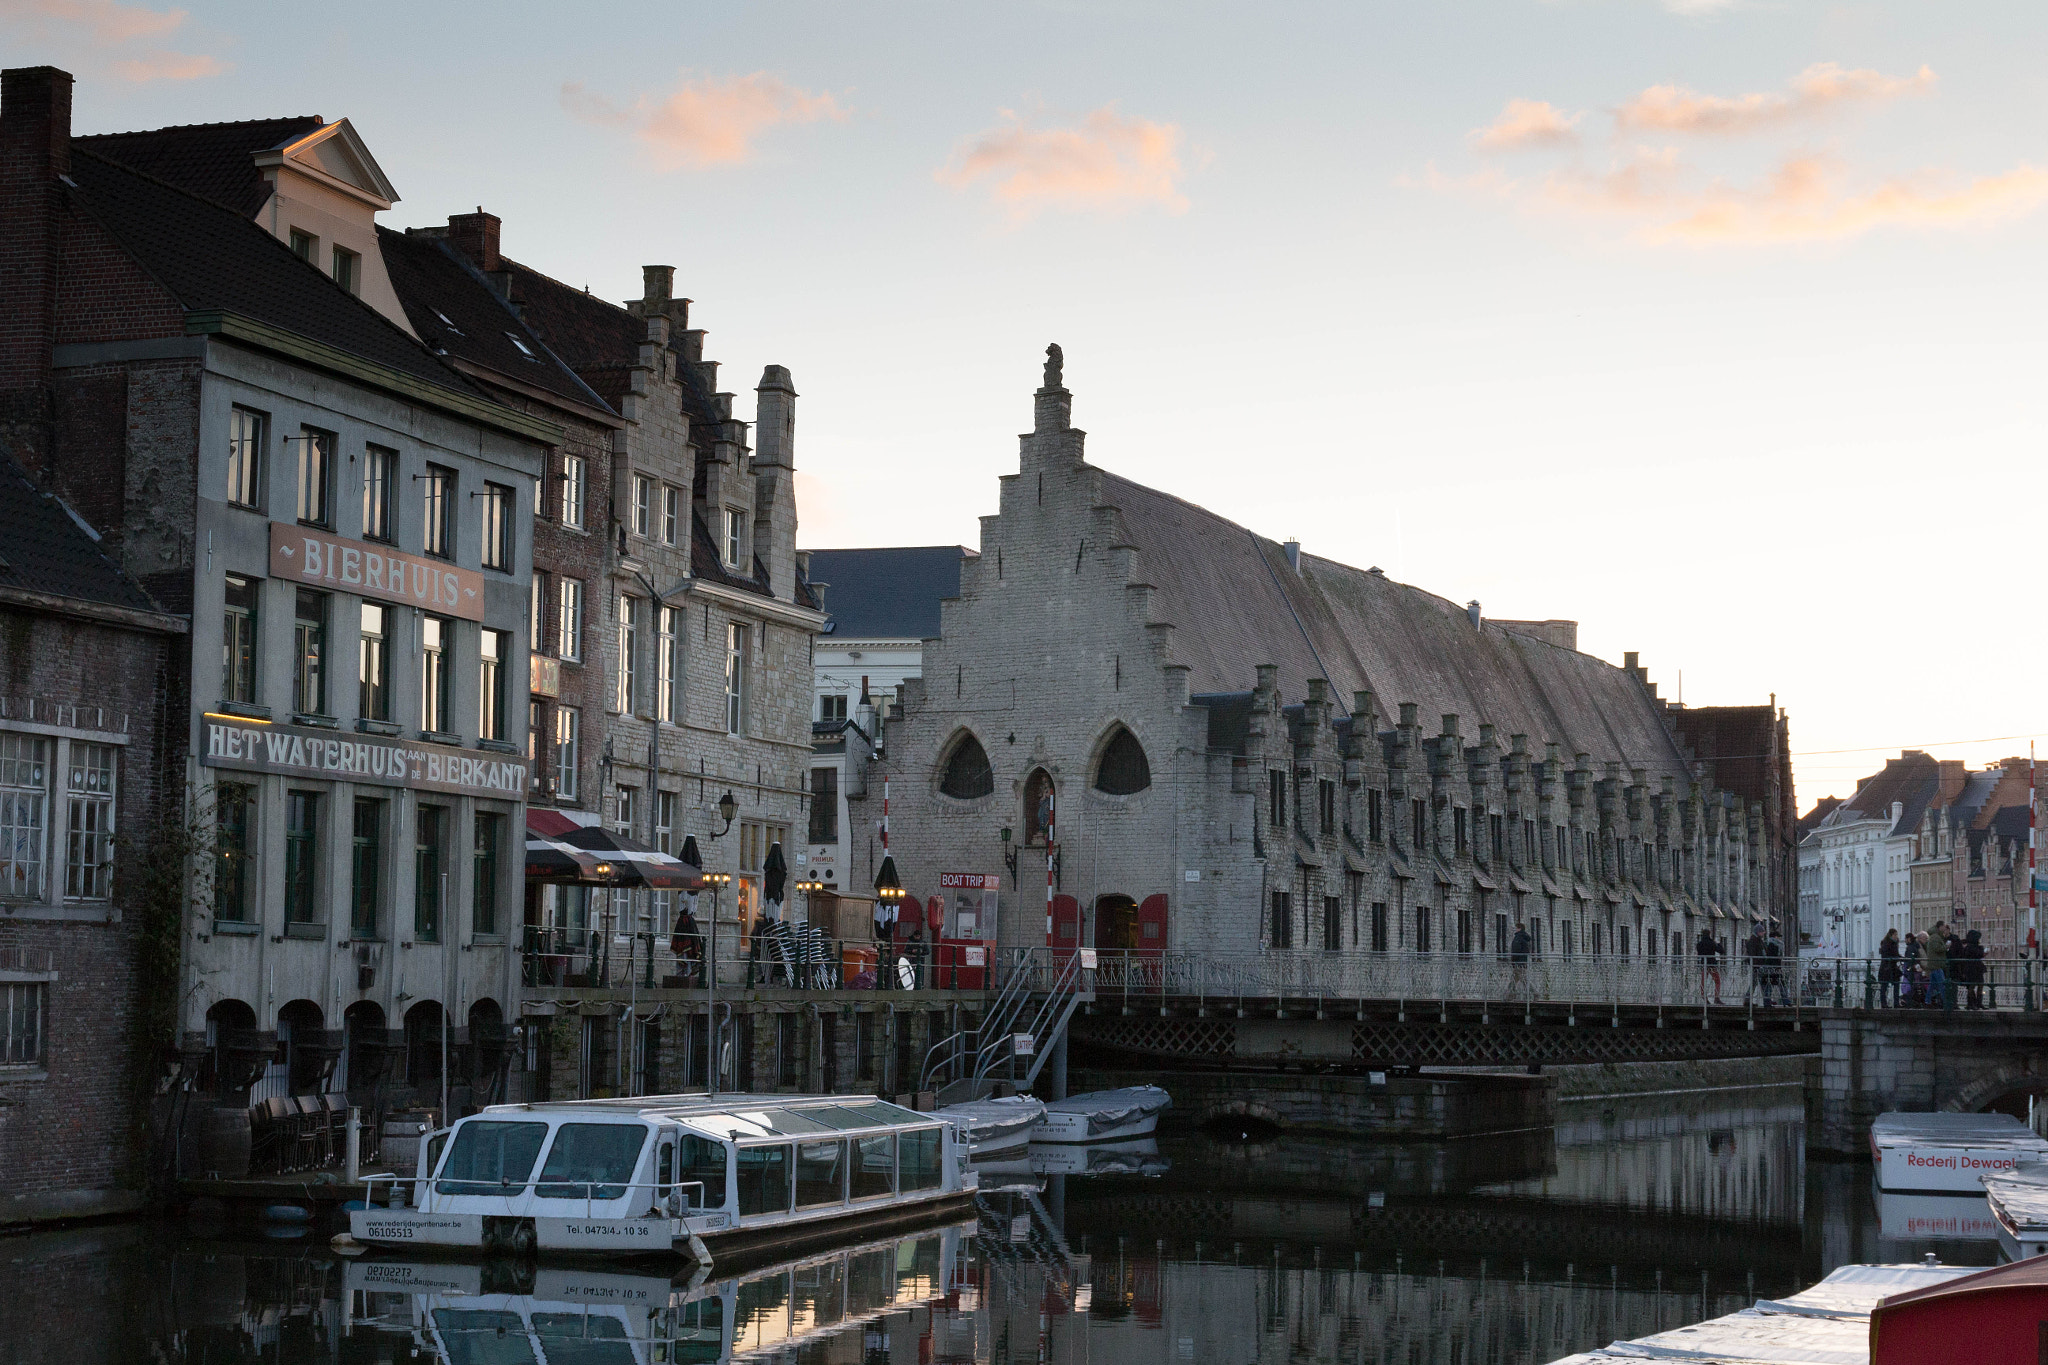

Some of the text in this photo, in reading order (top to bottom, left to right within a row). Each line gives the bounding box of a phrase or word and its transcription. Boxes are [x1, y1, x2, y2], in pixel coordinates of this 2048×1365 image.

[302, 537, 459, 607] BIERHUIS
[207, 723, 526, 793] HET WATERHUIS AAN DE BIERKANT
[942, 874, 984, 887] BOAT TRIP
[1907, 1154, 1957, 1170] Rederij
[366, 1220, 462, 1229] www.rederijdegentenaer.be
[566, 1225, 583, 1234] Tel.
[624, 1226, 635, 1236] 10
[637, 1226, 649, 1236] 36
[368, 1228, 413, 1238] 06105513
